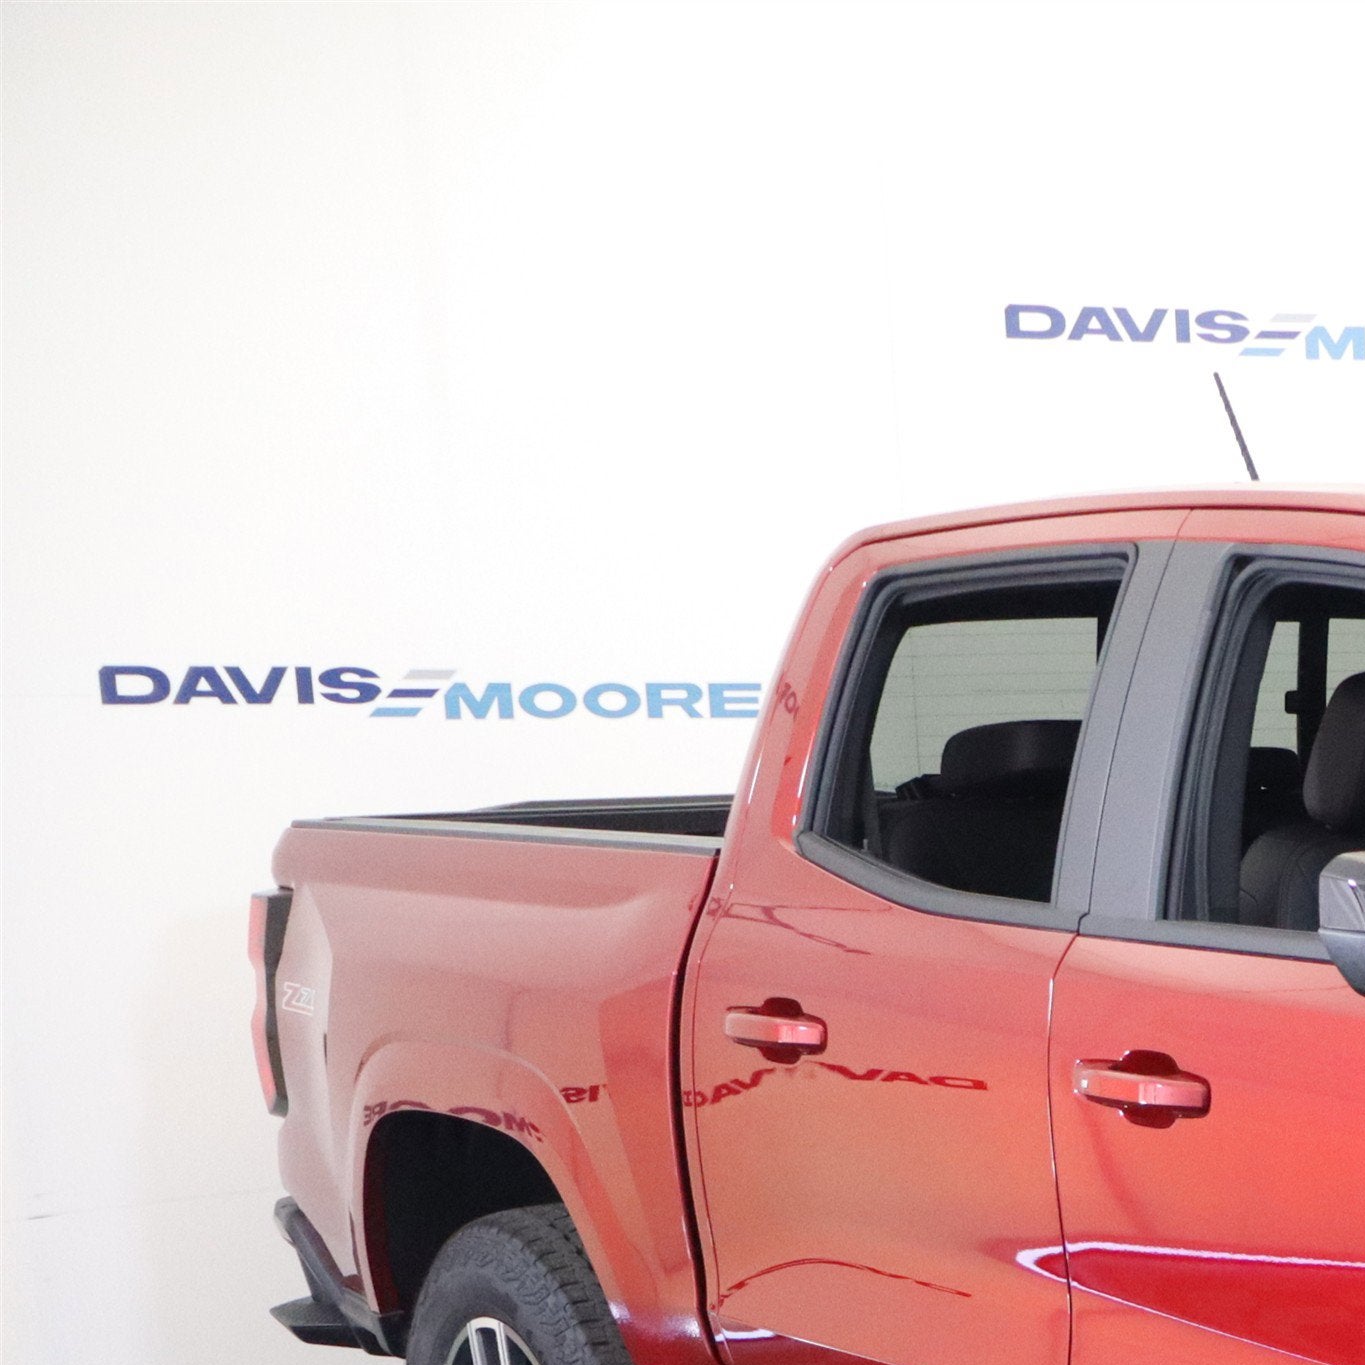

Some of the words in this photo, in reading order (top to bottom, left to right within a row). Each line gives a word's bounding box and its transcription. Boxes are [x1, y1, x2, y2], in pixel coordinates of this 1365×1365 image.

[1003, 303, 1250, 345] DAVIS
[98, 665, 382, 706] DAVIS
[444, 681, 763, 720] MOORE
